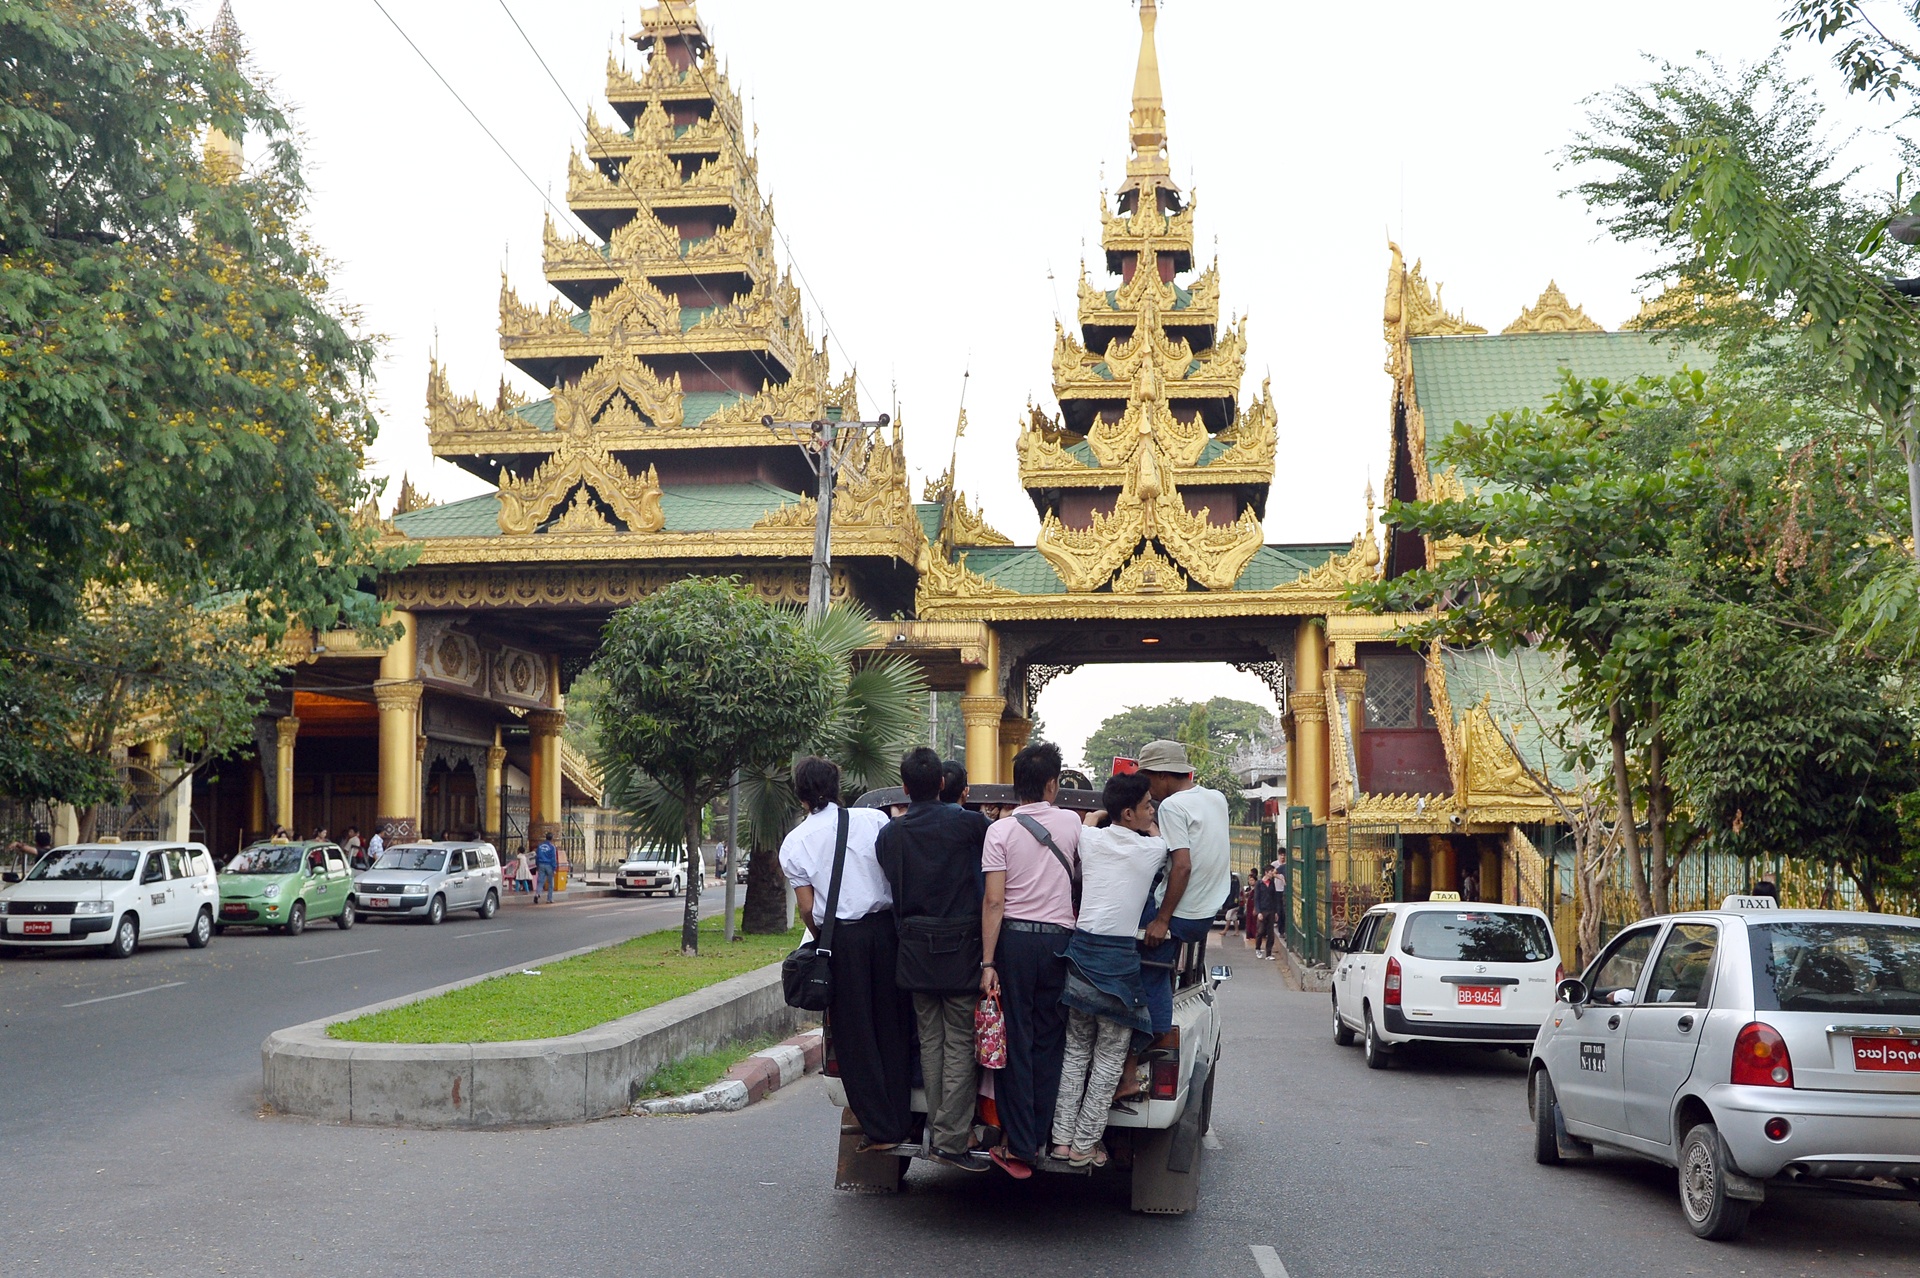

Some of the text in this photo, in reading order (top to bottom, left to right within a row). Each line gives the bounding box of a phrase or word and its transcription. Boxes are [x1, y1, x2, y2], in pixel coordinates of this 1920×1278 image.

[1738, 899, 1770, 909] TAXI
[1458, 990, 1500, 1004] BB-9454
[1857, 1045, 1920, 1065] ၁ဃ/၁၇၈
[1581, 1056, 1606, 1073] N-1848
